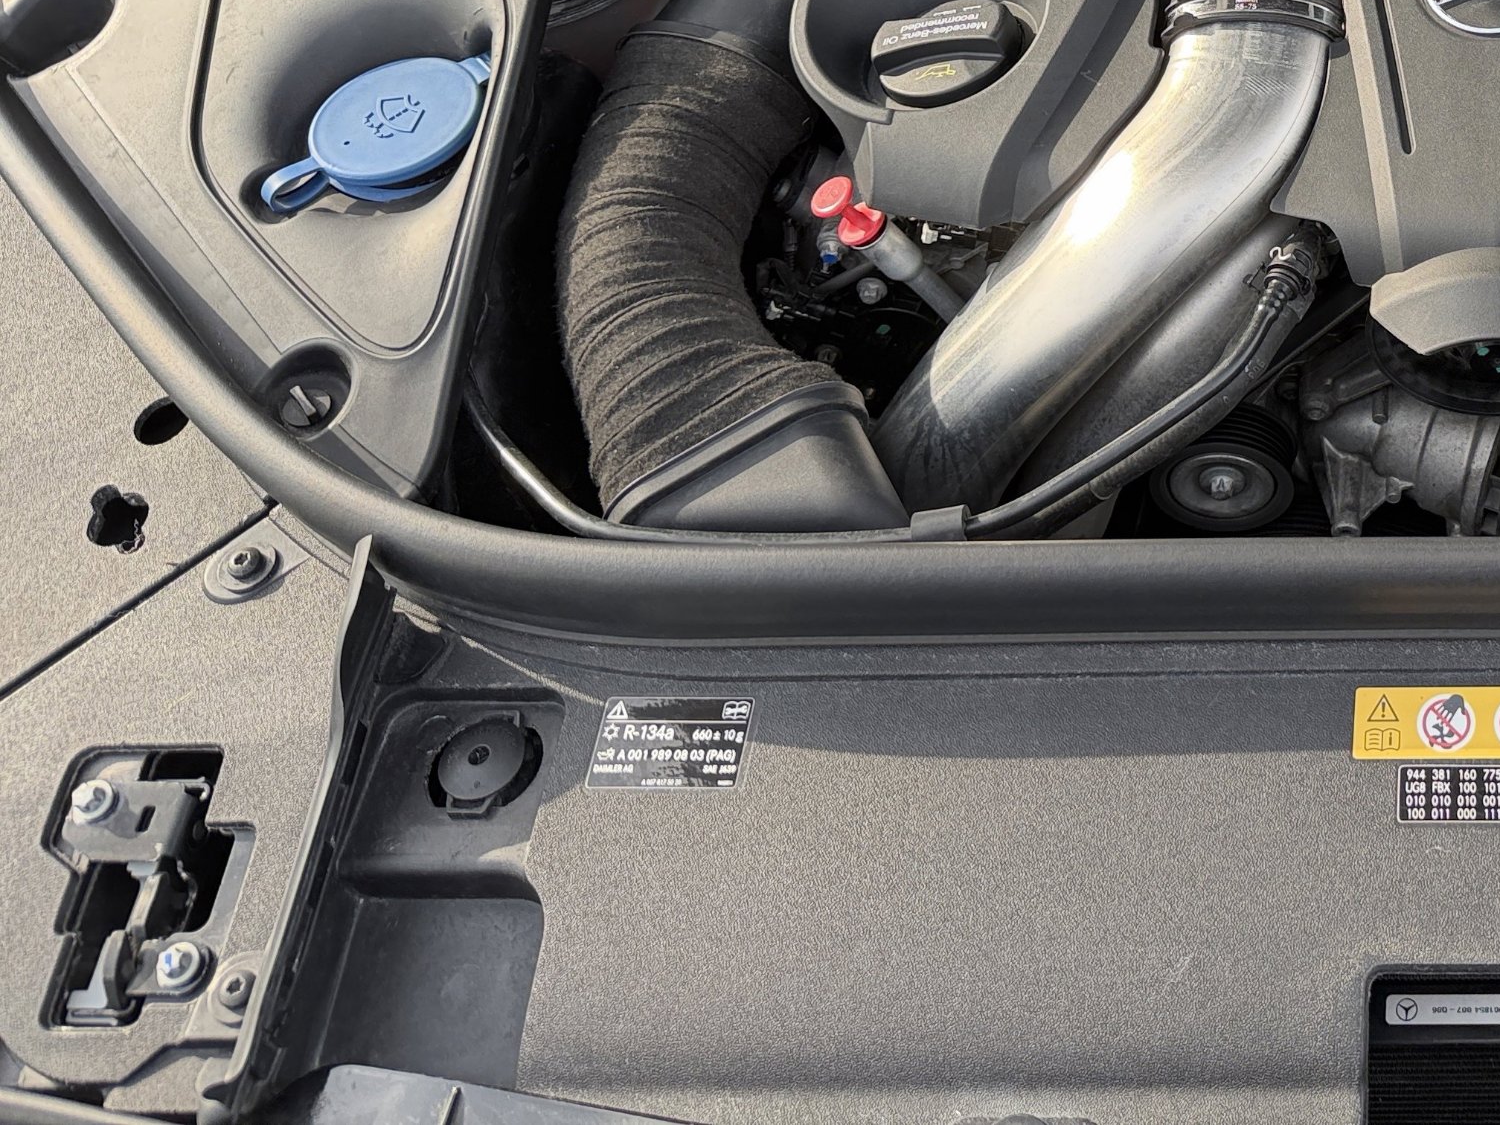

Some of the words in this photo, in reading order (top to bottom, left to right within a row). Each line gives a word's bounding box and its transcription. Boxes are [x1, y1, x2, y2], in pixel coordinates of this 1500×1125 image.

[900, 13, 980, 34] recommended
[901, 21, 987, 41] Mercedes-Benz
[883, 35, 897, 46] Oil
[623, 725, 674, 740] R-134a
[692, 729, 712, 741] 660
[723, 729, 734, 741] 10
[617, 749, 626, 761] A
[628, 749, 648, 761] 001
[650, 749, 671, 761] 989
[674, 749, 688, 761] 08
[690, 749, 704, 761] 03
[706, 749, 736, 763] (PAG)
[593, 764, 622, 773] DAIMLER
[622, 764, 633, 773] AG
[702, 764, 717, 774] SAE
[1407, 769, 1425, 780] 944
[1432, 769, 1450, 780] 381
[1459, 769, 1476, 780] 160
[1483, 769, 1500, 780] 775
[1432, 782, 1450, 793] FBX
[1459, 782, 1476, 793] 100
[1485, 782, 1500, 793] 101
[1406, 795, 1425, 806] 010
[1432, 795, 1451, 806] 010
[1457, 795, 1476, 806] 010
[1483, 795, 1500, 806] 001
[1407, 809, 1425, 819] 100
[1432, 809, 1449, 819] 011
[1457, 809, 1476, 819] 000
[1485, 809, 1500, 819] 111
